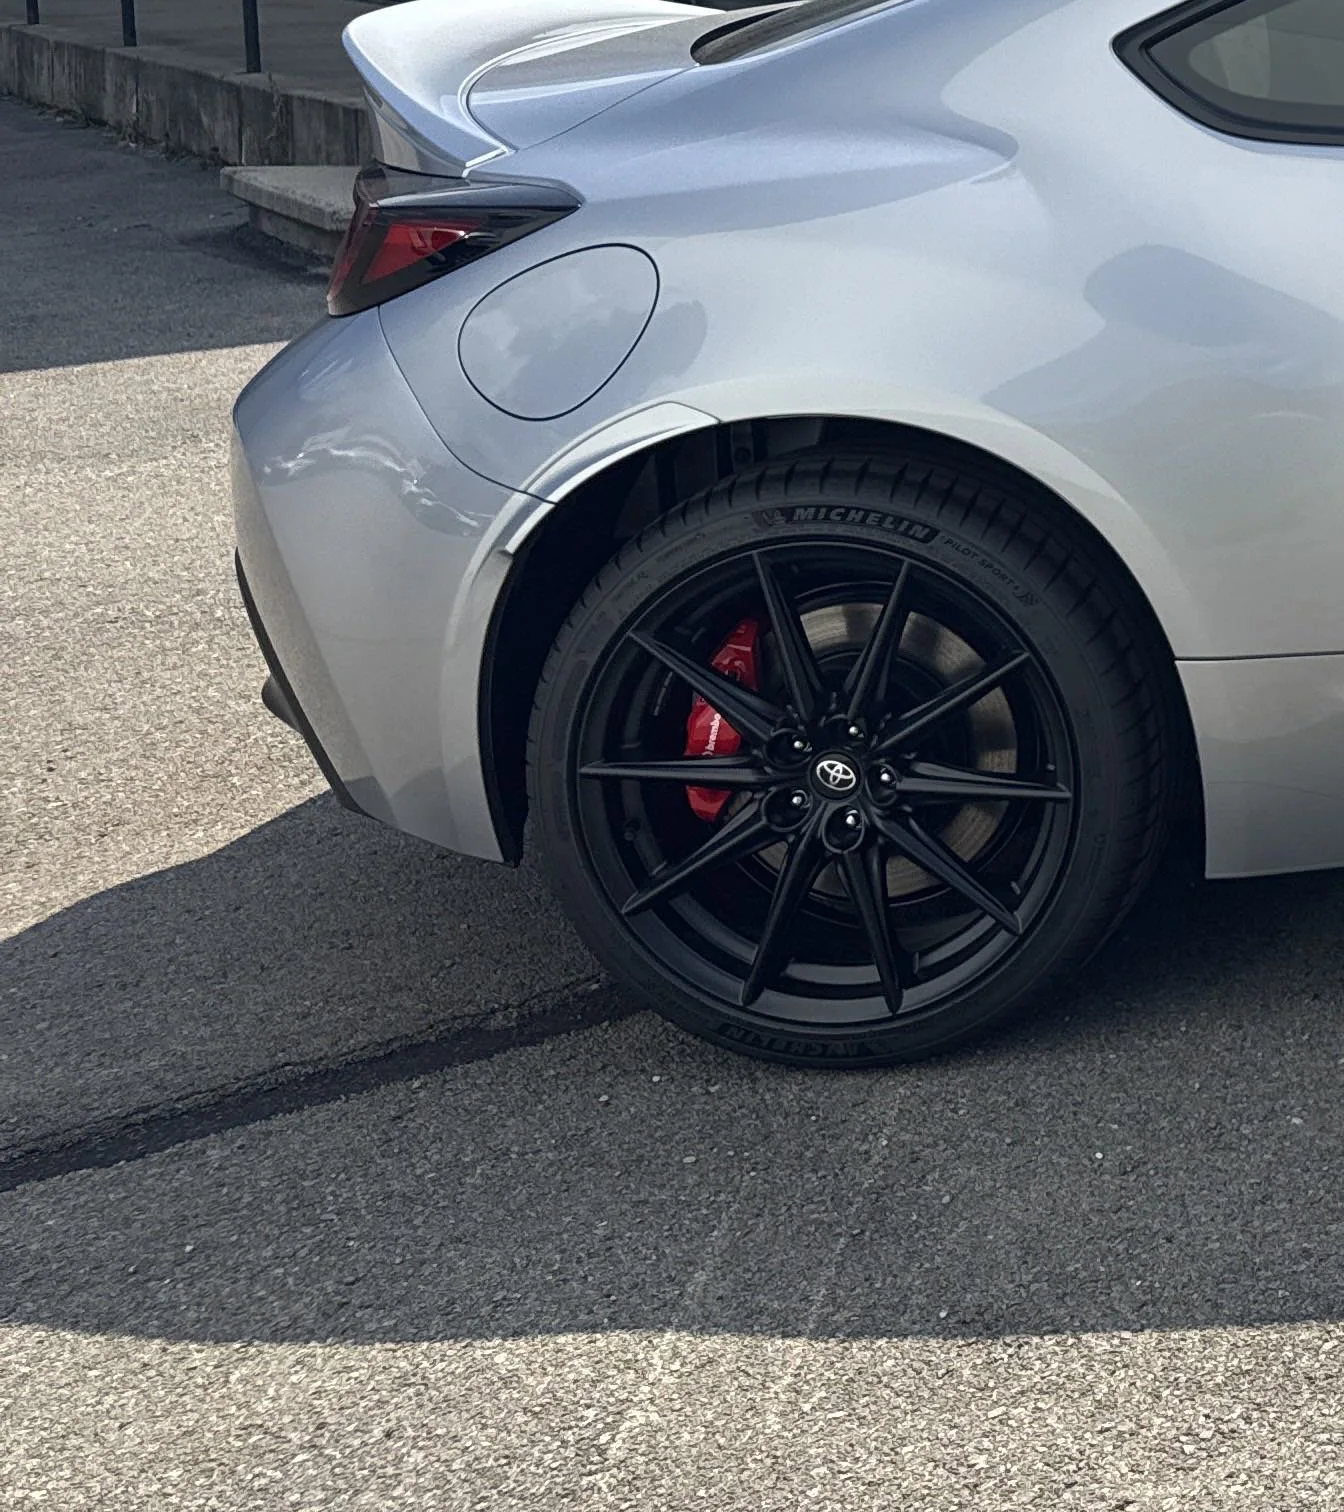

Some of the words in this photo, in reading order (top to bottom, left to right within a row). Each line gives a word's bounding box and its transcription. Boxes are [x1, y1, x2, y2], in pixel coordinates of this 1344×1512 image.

[793, 506, 931, 539] MICHELIN
[943, 538, 979, 559] PILOT
[977, 558, 1016, 585] SPORT
[704, 712, 722, 752] brembo
